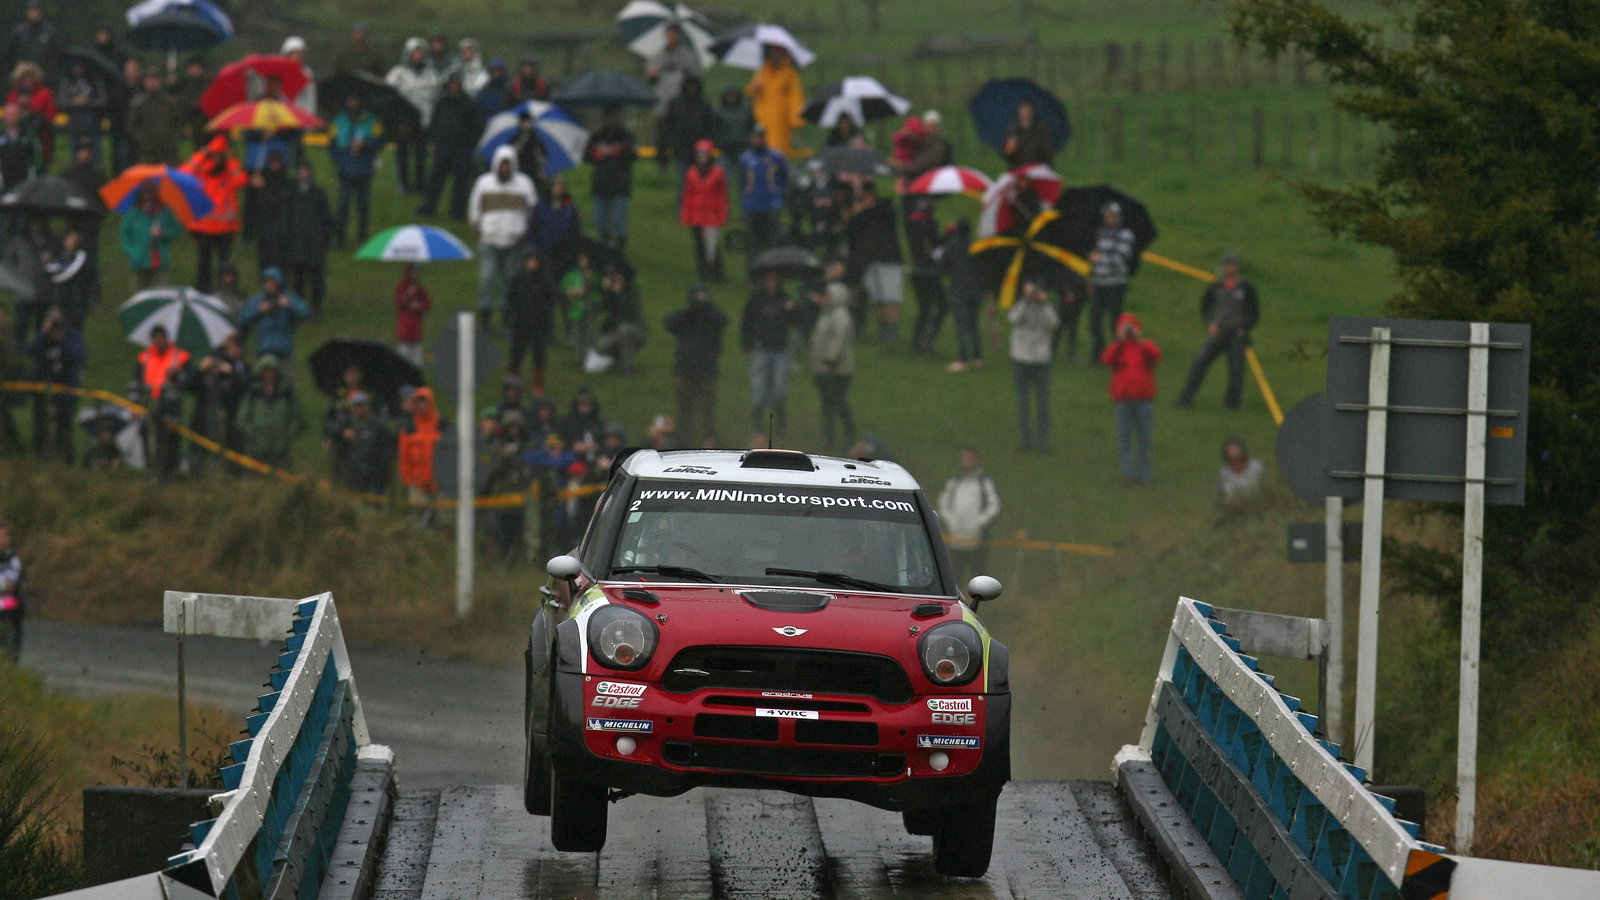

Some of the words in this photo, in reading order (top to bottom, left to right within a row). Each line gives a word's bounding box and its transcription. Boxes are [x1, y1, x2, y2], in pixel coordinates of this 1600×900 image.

[662, 467, 718, 476] LaRoca
[840, 477, 892, 487] LaRoca
[640, 488, 915, 513] www.MINImotorsport.com
[629, 500, 642, 512] 2
[607, 683, 642, 695] Castrol
[761, 691, 813, 699] prodrive
[591, 695, 644, 709] EDGE
[938, 700, 970, 710] Castrol
[931, 712, 976, 726] EDGE
[603, 721, 650, 730] MICHELIN
[932, 738, 977, 746] MICHELIN
